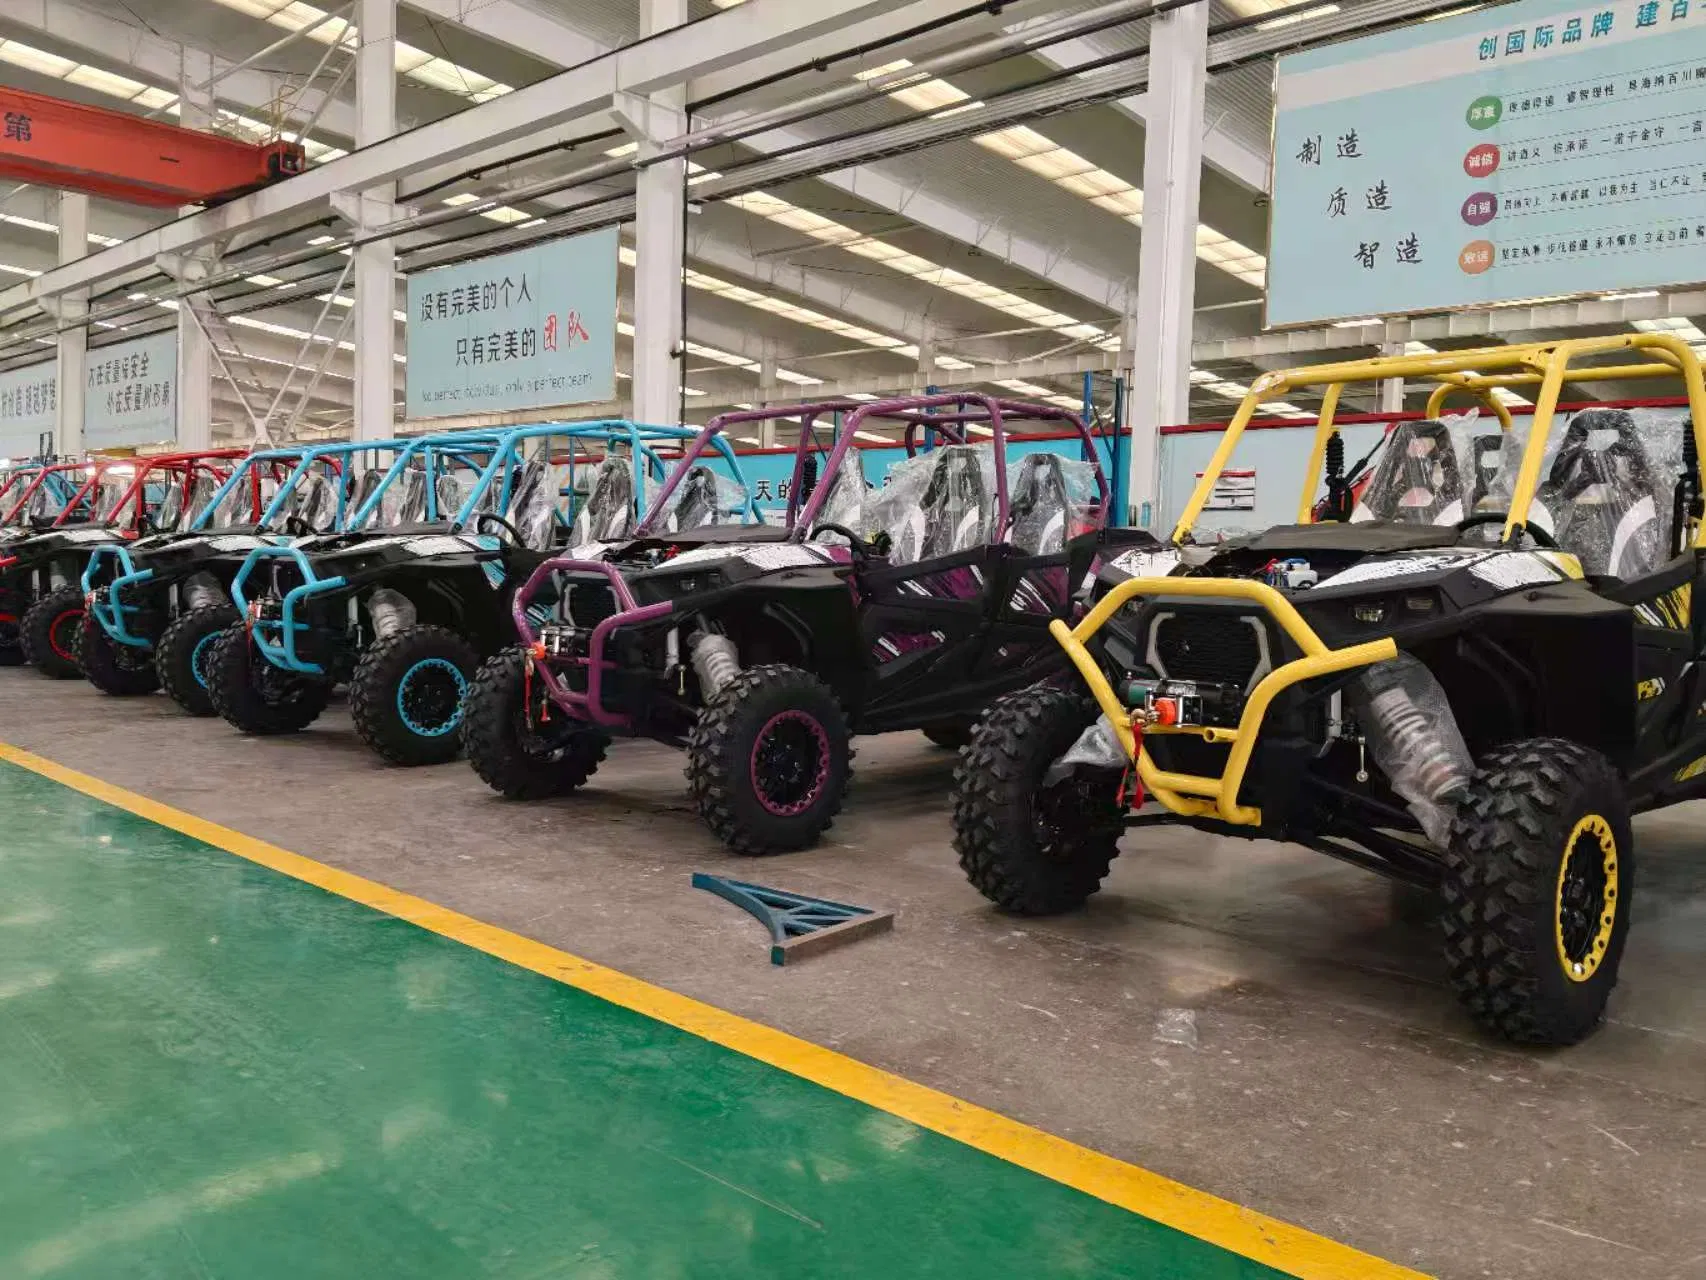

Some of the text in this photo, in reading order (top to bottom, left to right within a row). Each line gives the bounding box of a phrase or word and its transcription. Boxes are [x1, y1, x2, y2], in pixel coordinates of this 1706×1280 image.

[1478, 0, 1706, 61] 创国际品牌 建百
[1295, 128, 1363, 166] 制造
[1468, 152, 1494, 168] 诚信
[1327, 179, 1393, 217] 质造
[1467, 199, 1491, 216] 自强
[1353, 231, 1423, 270] 智造
[421, 272, 532, 322] 没有完美的个人
